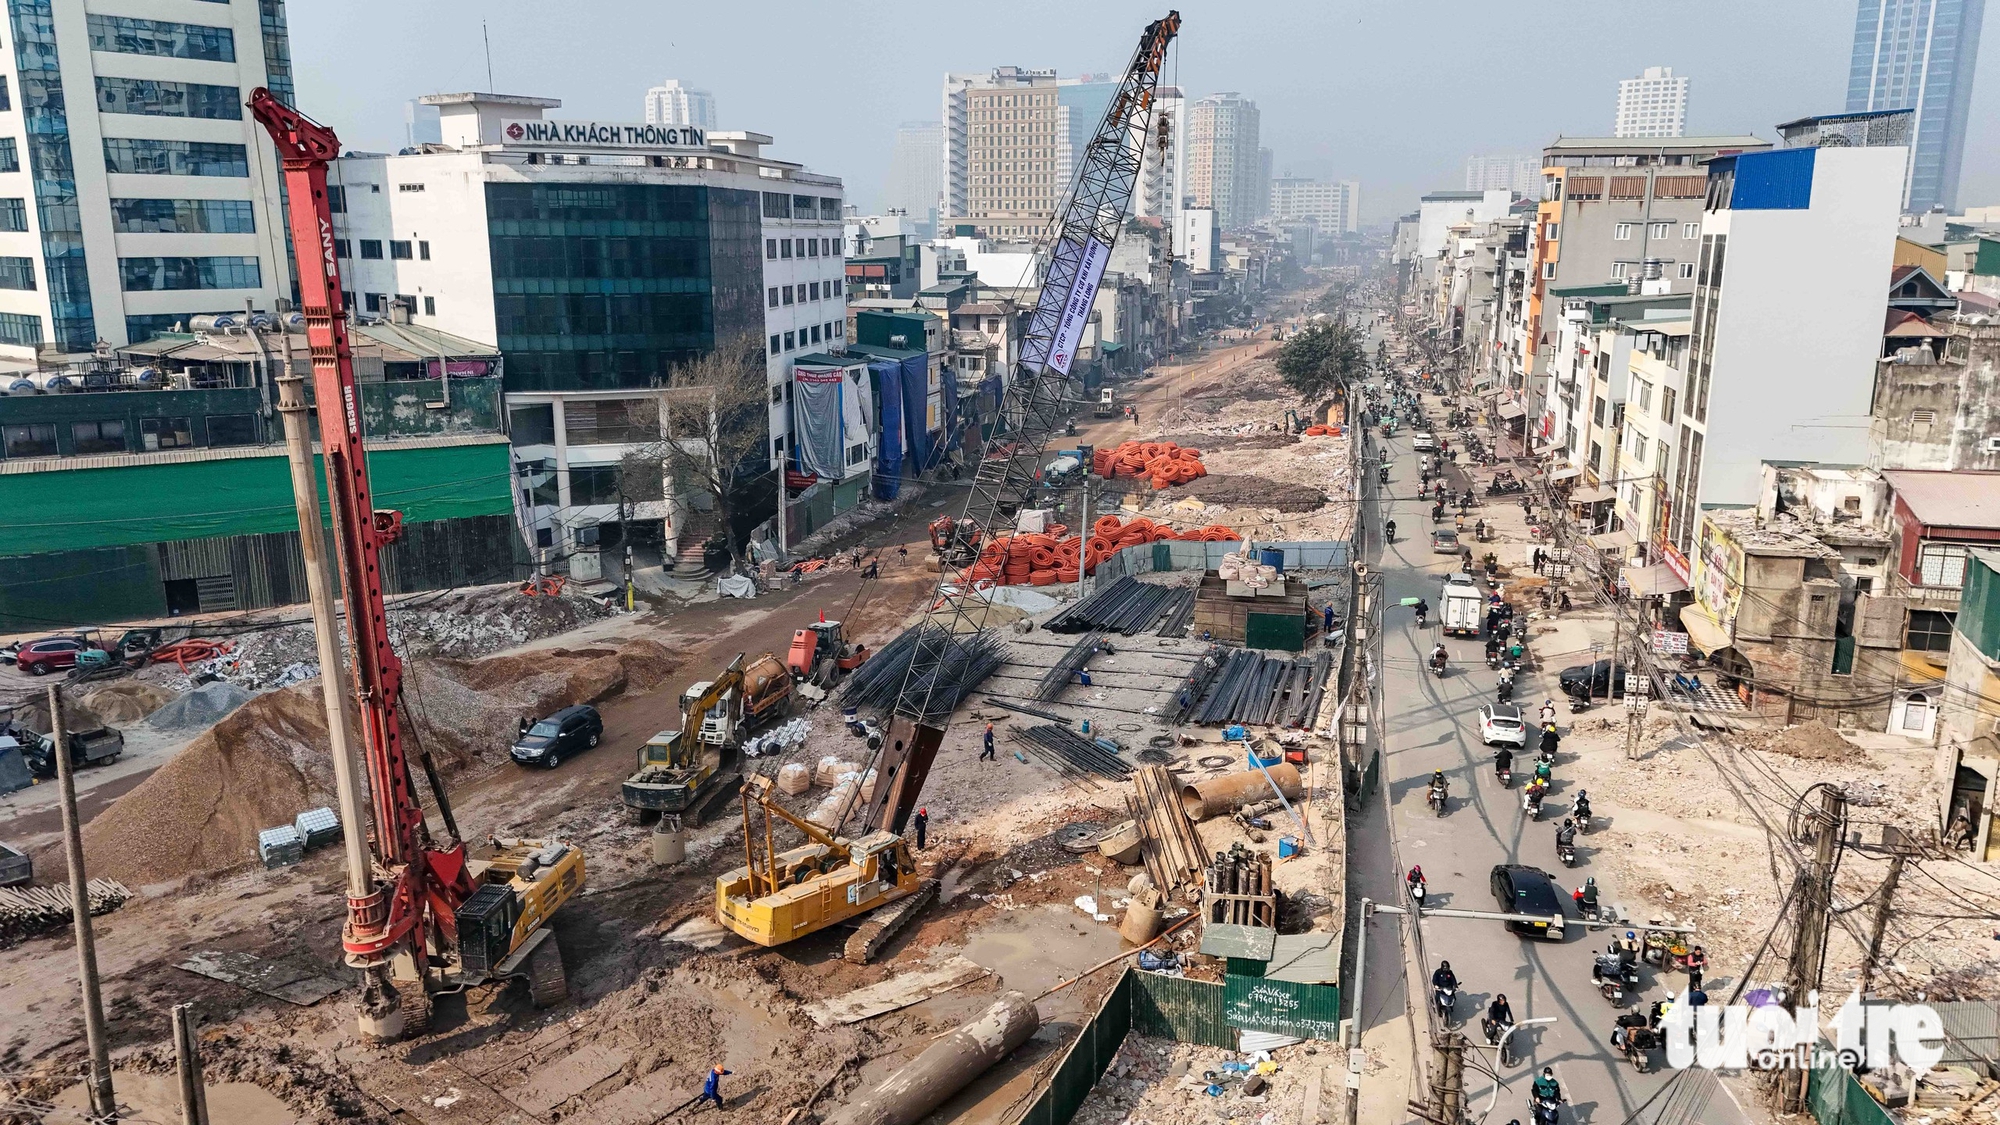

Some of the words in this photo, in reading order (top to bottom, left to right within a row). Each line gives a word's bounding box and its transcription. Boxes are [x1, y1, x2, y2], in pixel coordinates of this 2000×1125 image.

[526, 120, 561, 141] NHÀ
[565, 122, 620, 143] KHÁCH
[624, 124, 677, 144] THÔNG
[318, 218, 336, 277] SANY
[344, 385, 358, 434] SR360R
